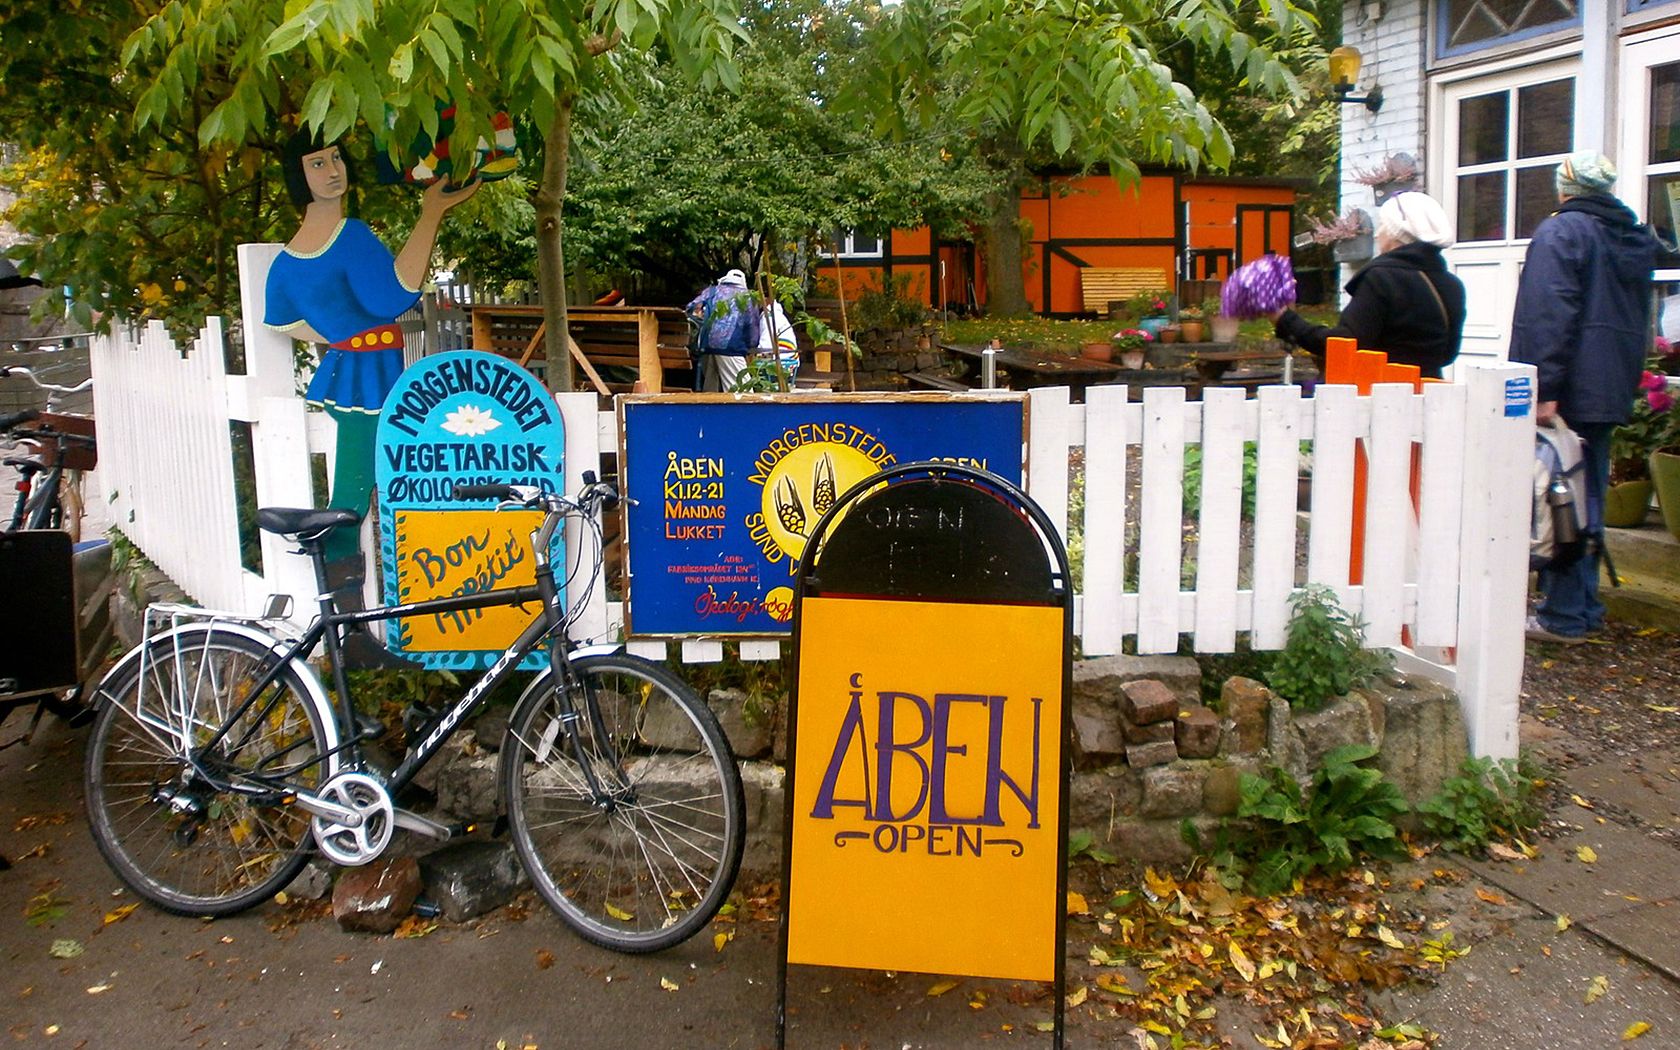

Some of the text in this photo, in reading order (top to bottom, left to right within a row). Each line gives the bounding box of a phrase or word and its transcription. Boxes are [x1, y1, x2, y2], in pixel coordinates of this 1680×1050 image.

[387, 358, 553, 437] MORGENSTEDET
[664, 451, 724, 480] ÅBEN
[747, 423, 897, 486] MORGENSTEDE
[412, 528, 490, 589] Bon
[745, 512, 784, 564] SUND
[809, 672, 1043, 829] ÅBEN
